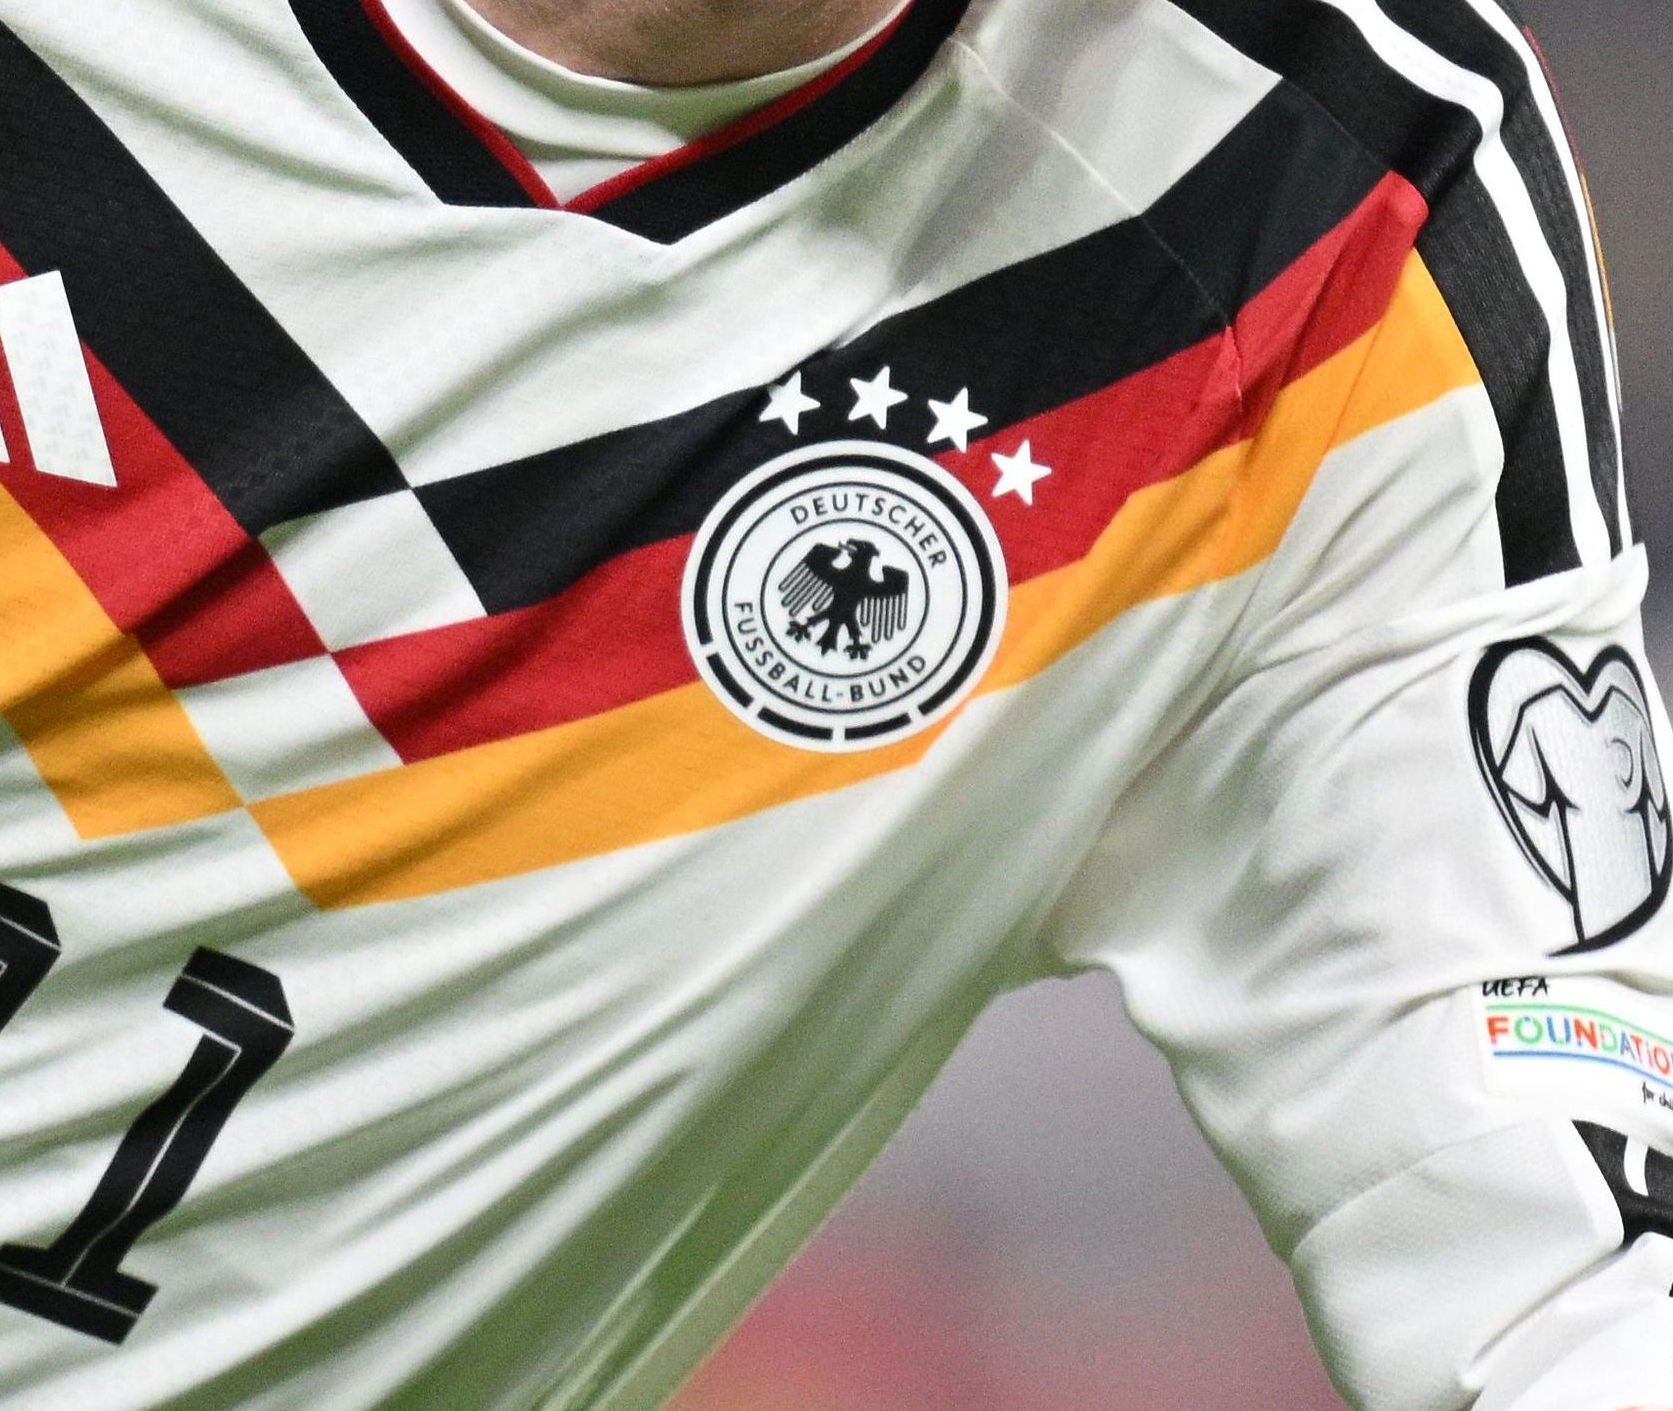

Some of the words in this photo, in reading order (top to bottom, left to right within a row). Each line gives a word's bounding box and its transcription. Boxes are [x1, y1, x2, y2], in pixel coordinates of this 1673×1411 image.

[791, 492, 948, 569] DEUTSCHER
[733, 600, 927, 704] FUSSBALL-BUND
[1482, 975, 1549, 997] UEFA
